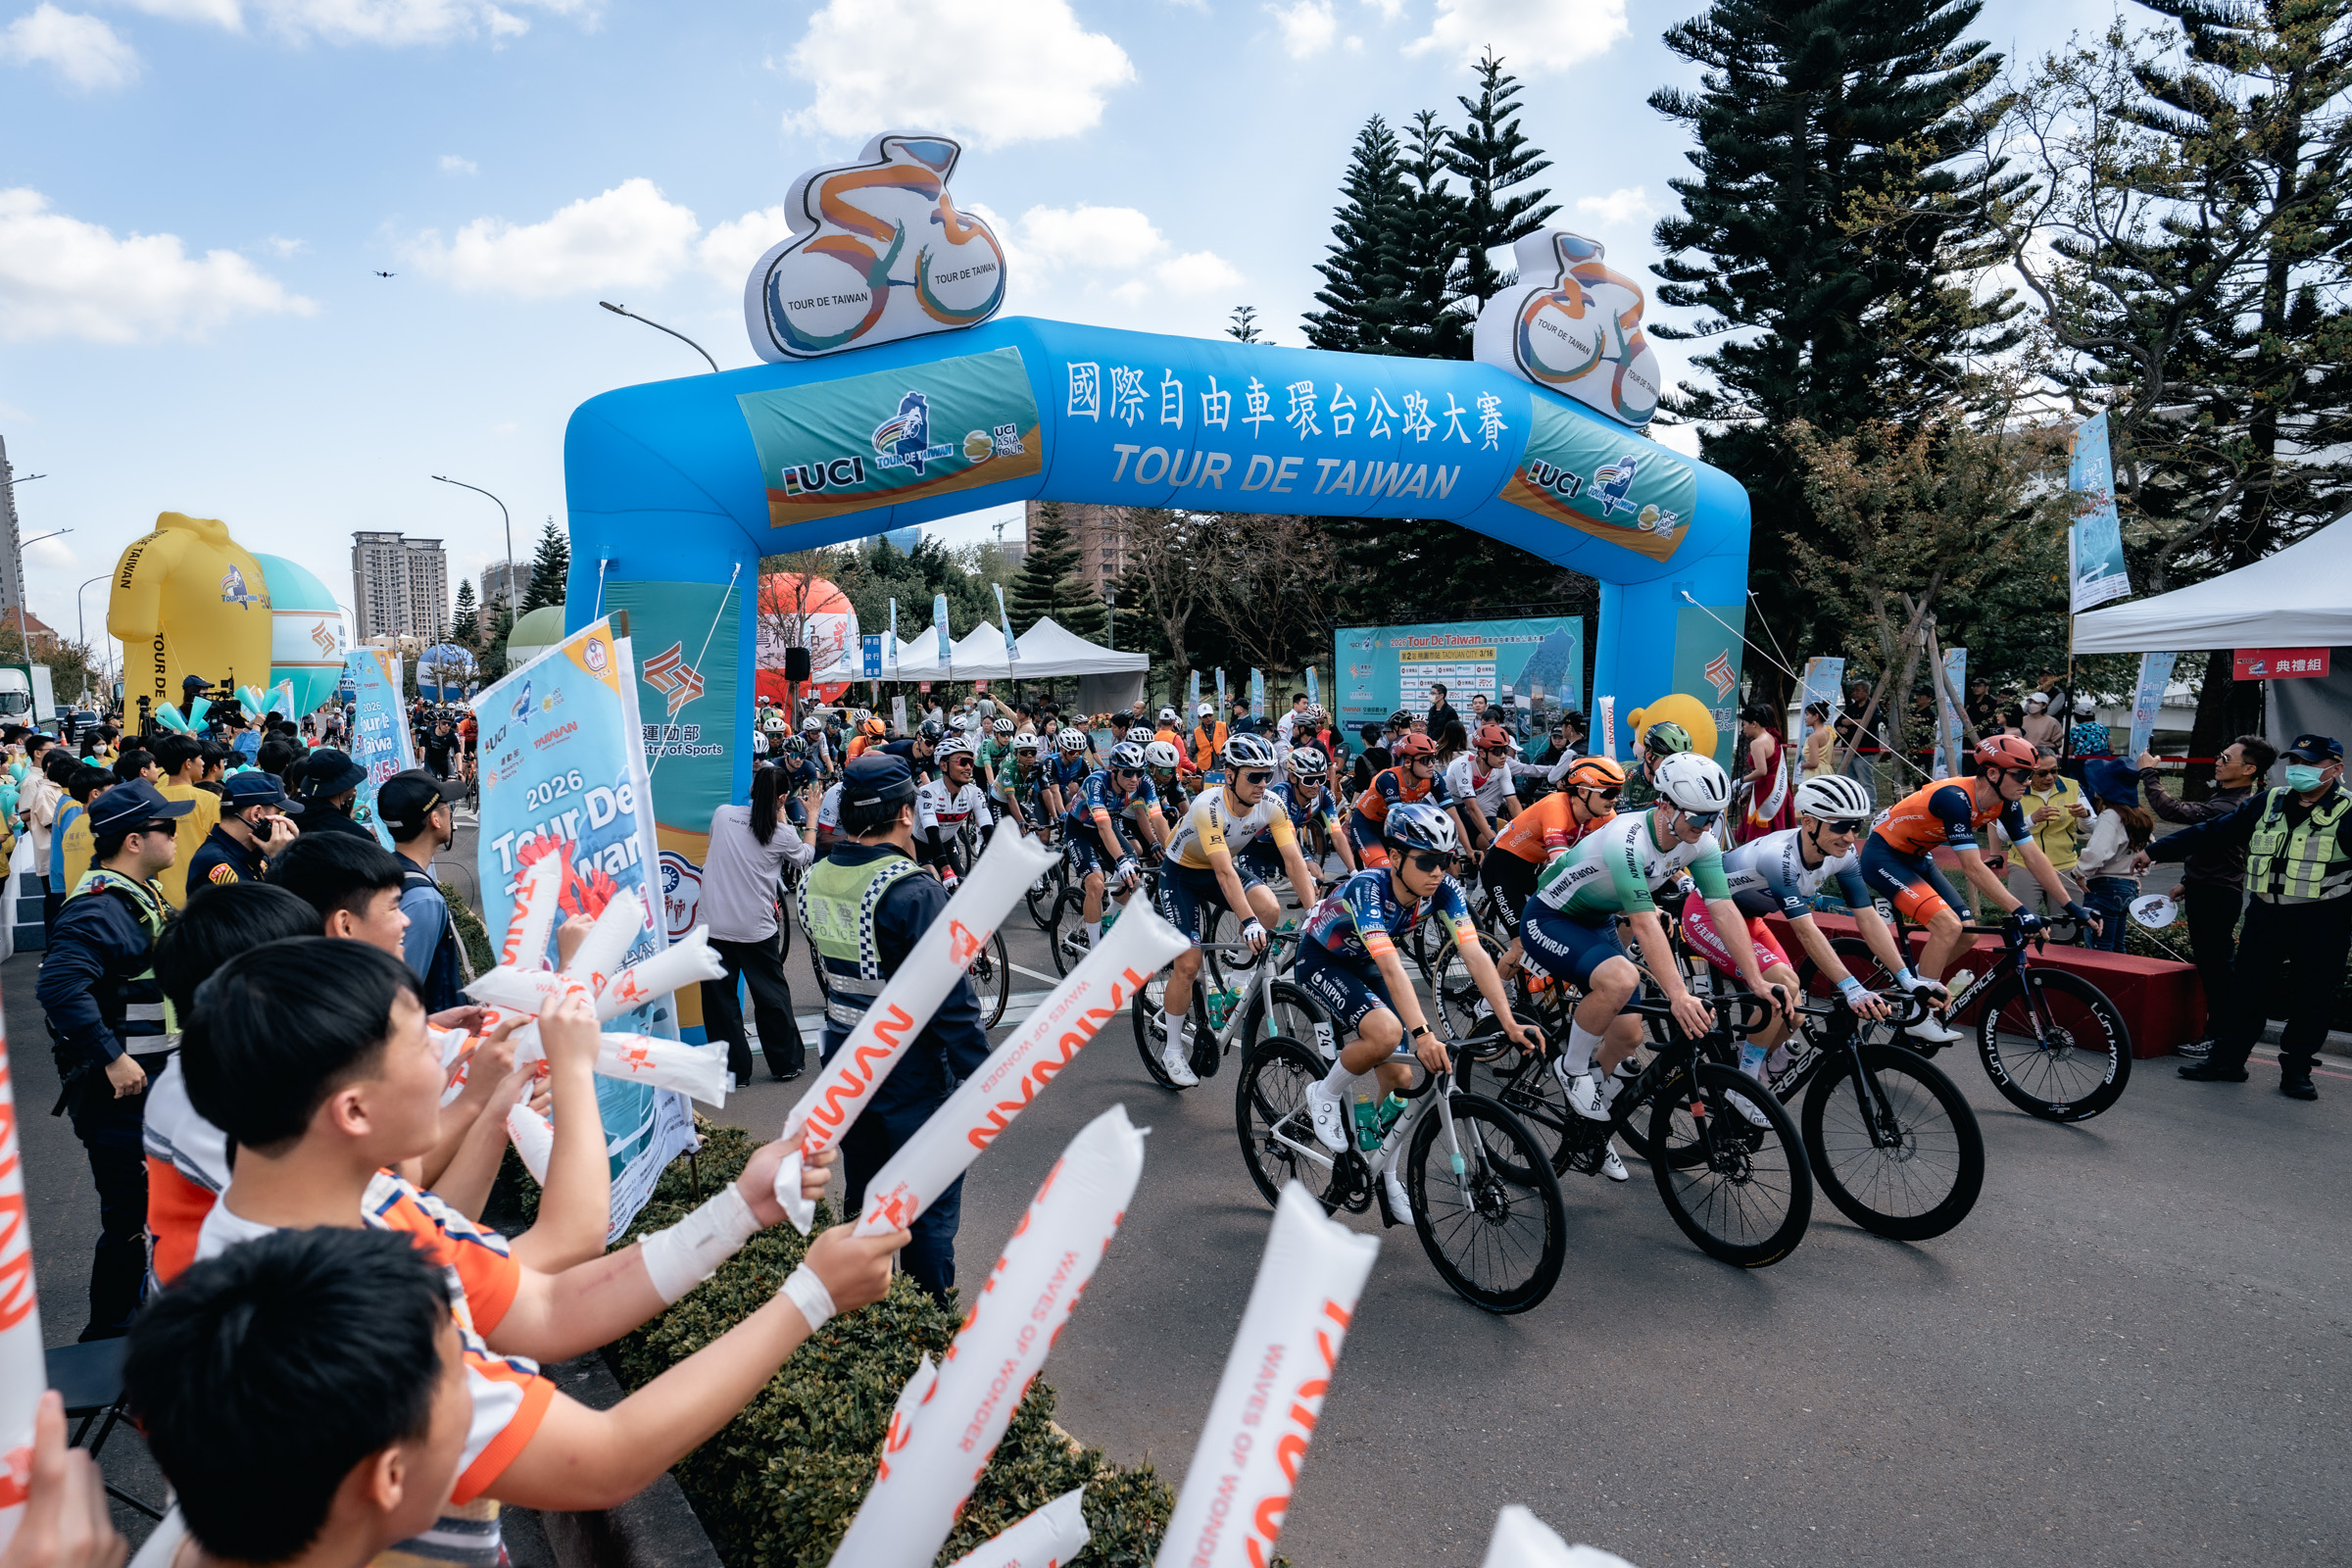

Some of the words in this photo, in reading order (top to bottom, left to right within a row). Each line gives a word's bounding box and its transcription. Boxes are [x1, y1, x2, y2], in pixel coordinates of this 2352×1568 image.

[935, 273, 957, 284] TOUR
[959, 270, 971, 281] DE
[972, 263, 997, 277] TAIWAN
[788, 299, 814, 311] TOUR
[817, 296, 830, 307] DE
[832, 292, 868, 306] TAIWAN
[1539, 318, 1557, 334] TOUR
[1557, 329, 1568, 341] DE
[1568, 336, 1591, 356] TAIWAN
[1628, 369, 1640, 381] TOUR
[1066, 361, 1508, 451] 國際自由車環台公路大賽
[995, 423, 1015, 437] UCI
[876, 454, 904, 469] TOUR
[905, 451, 916, 464] DE
[916, 444, 953, 463] TAIWAN
[998, 443, 1024, 457] TOUR
[800, 458, 864, 489] UCI
[1111, 443, 1232, 490] TOUR
[1239, 455, 1304, 494] DE
[1311, 459, 1461, 500] TAIWAN
[1540, 464, 1583, 498] UCI
[1588, 486, 1605, 500] TOUR
[121, 548, 143, 589] TAIWAN
[154, 632, 166, 674] TOUR
[1408, 636, 1428, 647] Tour
[1431, 635, 1444, 646] De
[1445, 634, 1481, 645] Taiwan
[2276, 659, 2322, 672] 典禮組
[155, 677, 167, 699] DE
[364, 736, 392, 755] Taiwa
[489, 724, 507, 751] UCI
[534, 721, 577, 750] TAIWAN
[643, 725, 700, 741] 運動部
[669, 745, 683, 756] of
[685, 745, 722, 756] Sports
[1980, 739, 1998, 757] KASK
[526, 769, 583, 811] 2026
[1772, 790, 1781, 806] CITY
[584, 785, 635, 831] De
[1277, 801, 1289, 820] TAIWAN
[1626, 834, 1636, 846] DE
[1629, 822, 1642, 835] TOUR
[2254, 835, 2275, 847] 警察
[1070, 847, 1081, 867] NIPPO
[1626, 847, 1641, 879] TAIWAN
[1578, 865, 1598, 879] TOUR
[1736, 875, 1755, 887] TOUR
[1442, 875, 1466, 907] FANTINI
[812, 898, 855, 928] 警察
[1494, 885, 1520, 927] euskaltel
[1876, 899, 1890, 919] 162
[813, 925, 857, 942] POLICE
[1312, 907, 1340, 937] FANTINI
[1527, 918, 1570, 957] BODYWRAP
[1047, 981, 1091, 1026] WAVES
[1320, 980, 1346, 1009] NIPPO
[1435, 971, 1446, 1021] LIMITED
[1945, 968, 1996, 1021] WINSPACE
[1034, 1021, 1051, 1043] OF
[1318, 1029, 1332, 1047] 24
[1986, 1008, 1999, 1051] HYPER
[968, 967, 1153, 1151] TAIWAN
[980, 1039, 1034, 1094] WONDER
[1772, 1047, 1823, 1096] RBEA
[2104, 1039, 2117, 1085] HYPER
[1034, 1251, 1079, 1321] WAVES
[1013, 1325, 1037, 1358] OF
[1243, 1344, 1286, 1429] WAVES
[958, 1353, 1022, 1453] WONDER
[1230, 1433, 1252, 1471] OF
[1189, 1473, 1240, 1568] WONDE
